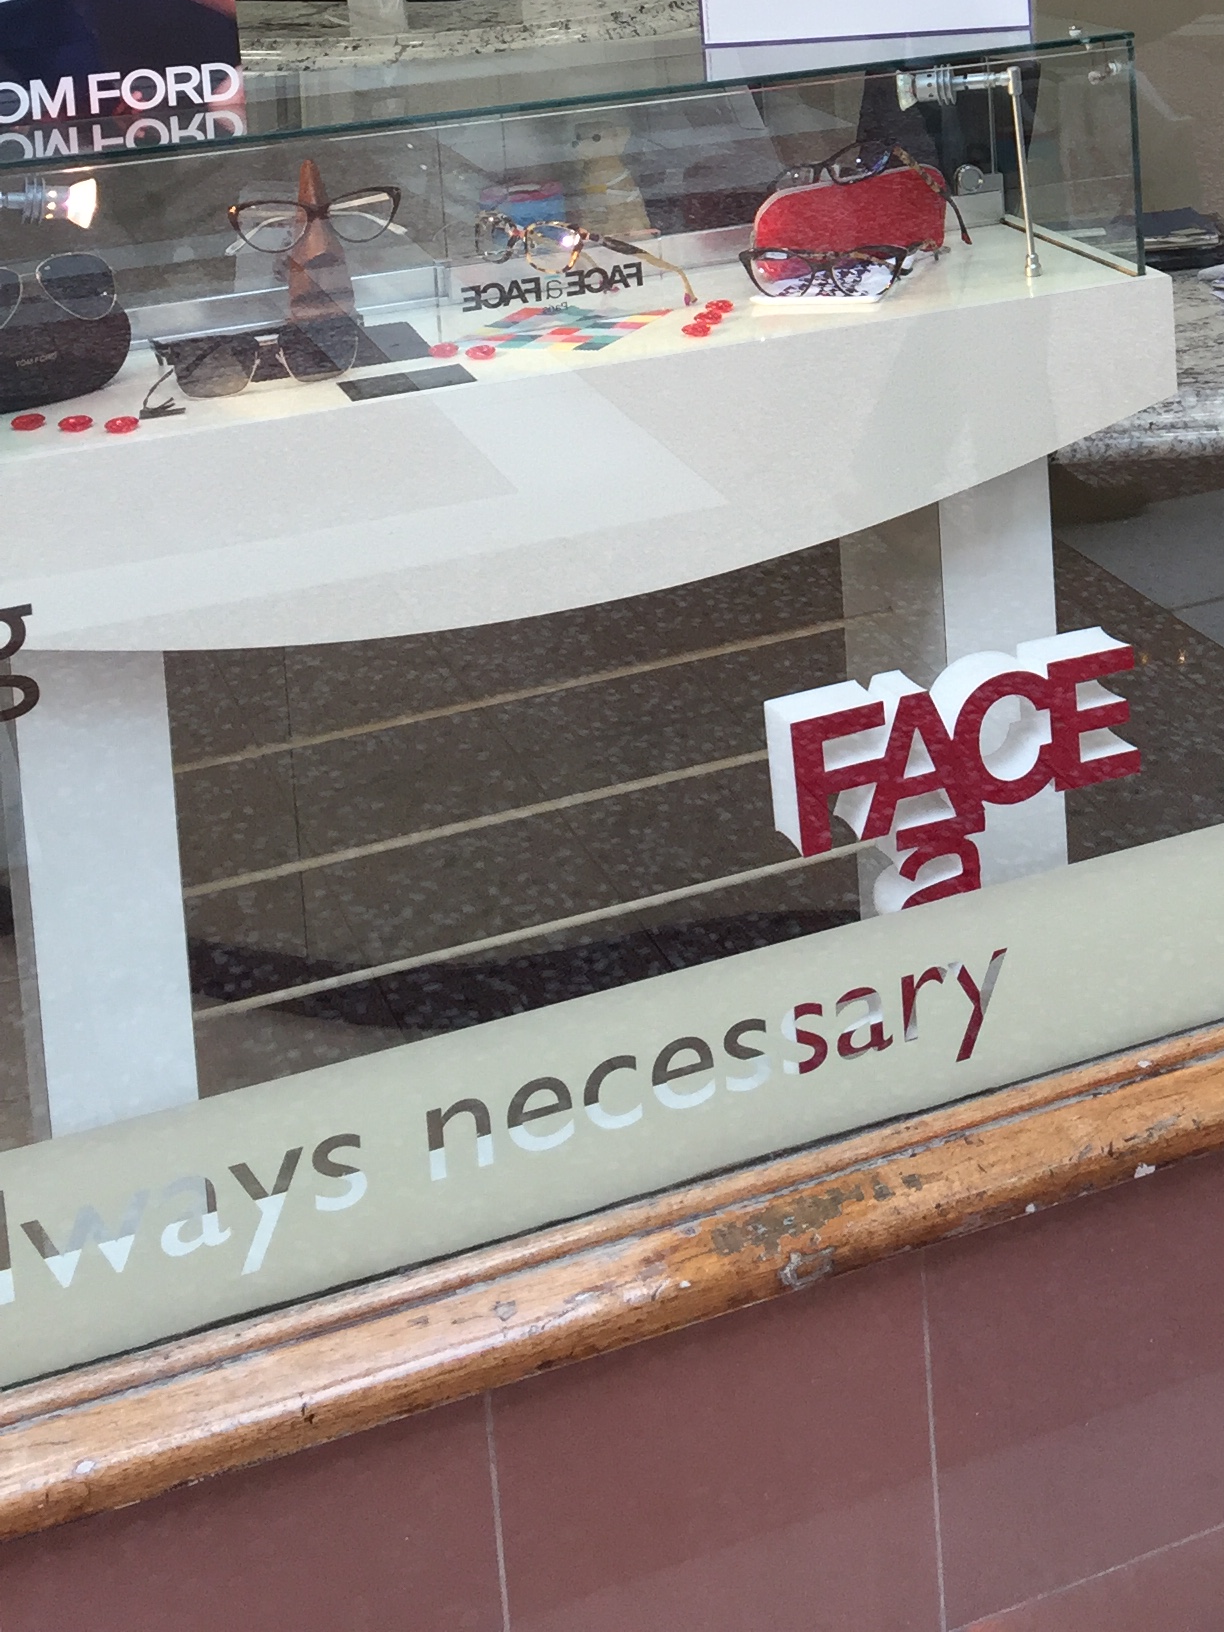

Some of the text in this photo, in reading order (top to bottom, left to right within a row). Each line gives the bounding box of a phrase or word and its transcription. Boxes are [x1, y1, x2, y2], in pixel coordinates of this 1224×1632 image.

[88, 62, 241, 115] FORD
[788, 644, 1142, 858] FACE
[424, 946, 1008, 1183] necessary
